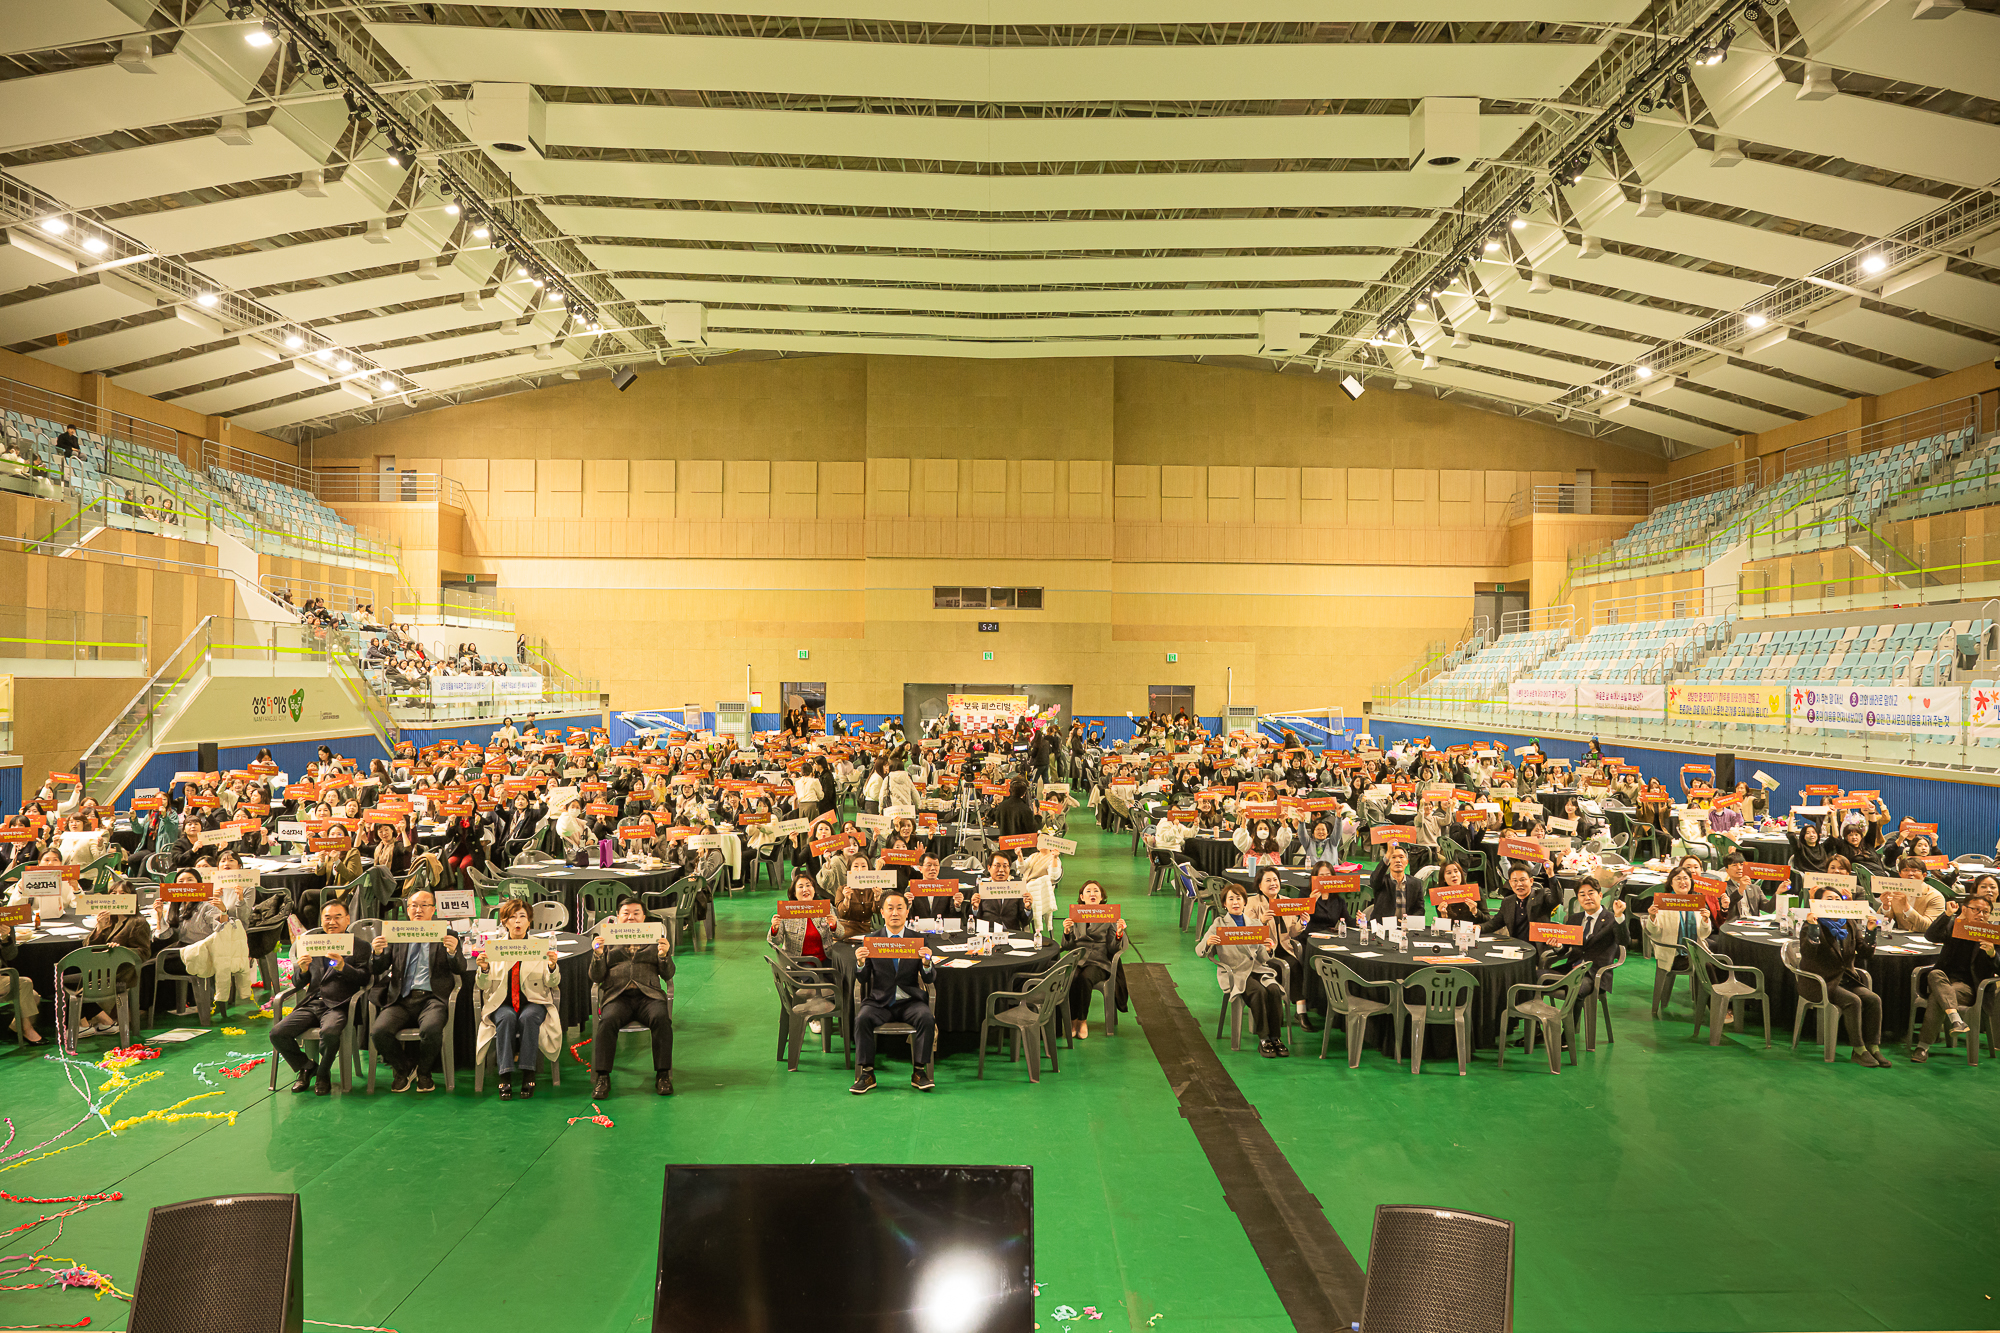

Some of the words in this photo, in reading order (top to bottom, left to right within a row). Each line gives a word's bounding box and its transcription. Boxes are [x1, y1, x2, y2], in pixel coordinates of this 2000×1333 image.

[964, 702, 979, 711] 보육
[981, 702, 1010, 711] 페스티벌
[26, 881, 56, 889] 수상자석
[441, 901, 469, 909] 내빈석
[1322, 966, 1338, 978] CH
[1432, 977, 1455, 988] CH
